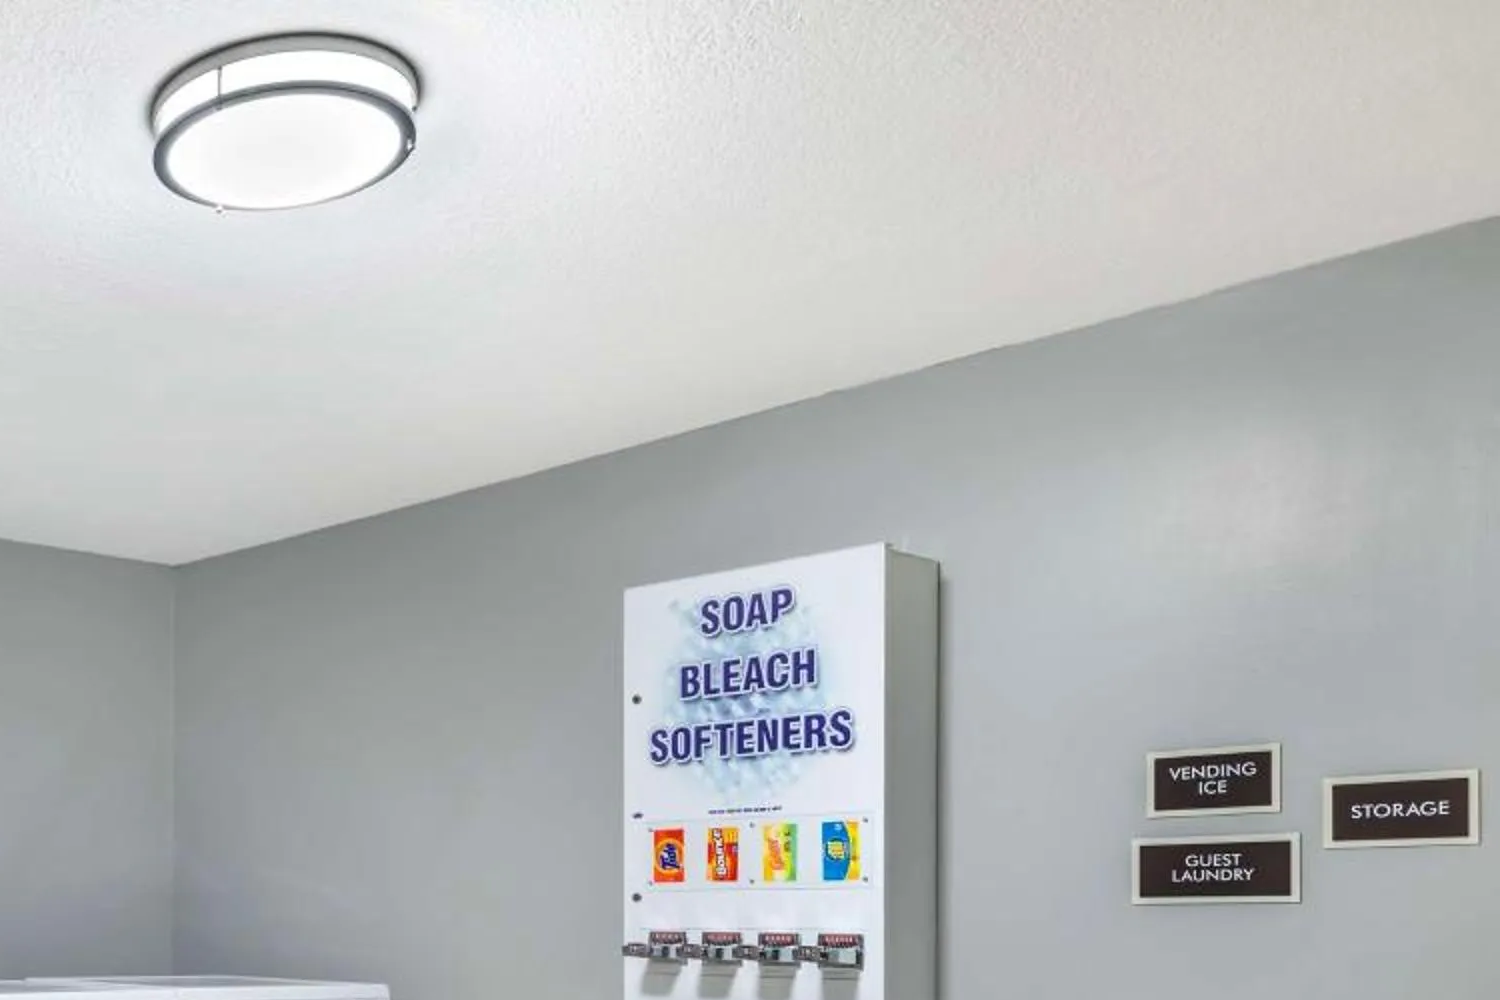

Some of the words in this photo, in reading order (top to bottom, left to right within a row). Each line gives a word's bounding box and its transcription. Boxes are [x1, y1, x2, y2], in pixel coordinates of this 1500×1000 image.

[700, 587, 796, 636] SOAP
[679, 648, 817, 699] BLEACH
[649, 709, 854, 763] SOFTENERS
[1169, 761, 1257, 781] VENDING
[1199, 779, 1227, 795] ICE
[1351, 799, 1450, 820] STORAGE
[1185, 852, 1243, 868] GUEST
[1171, 867, 1255, 883] LAUNDRY
